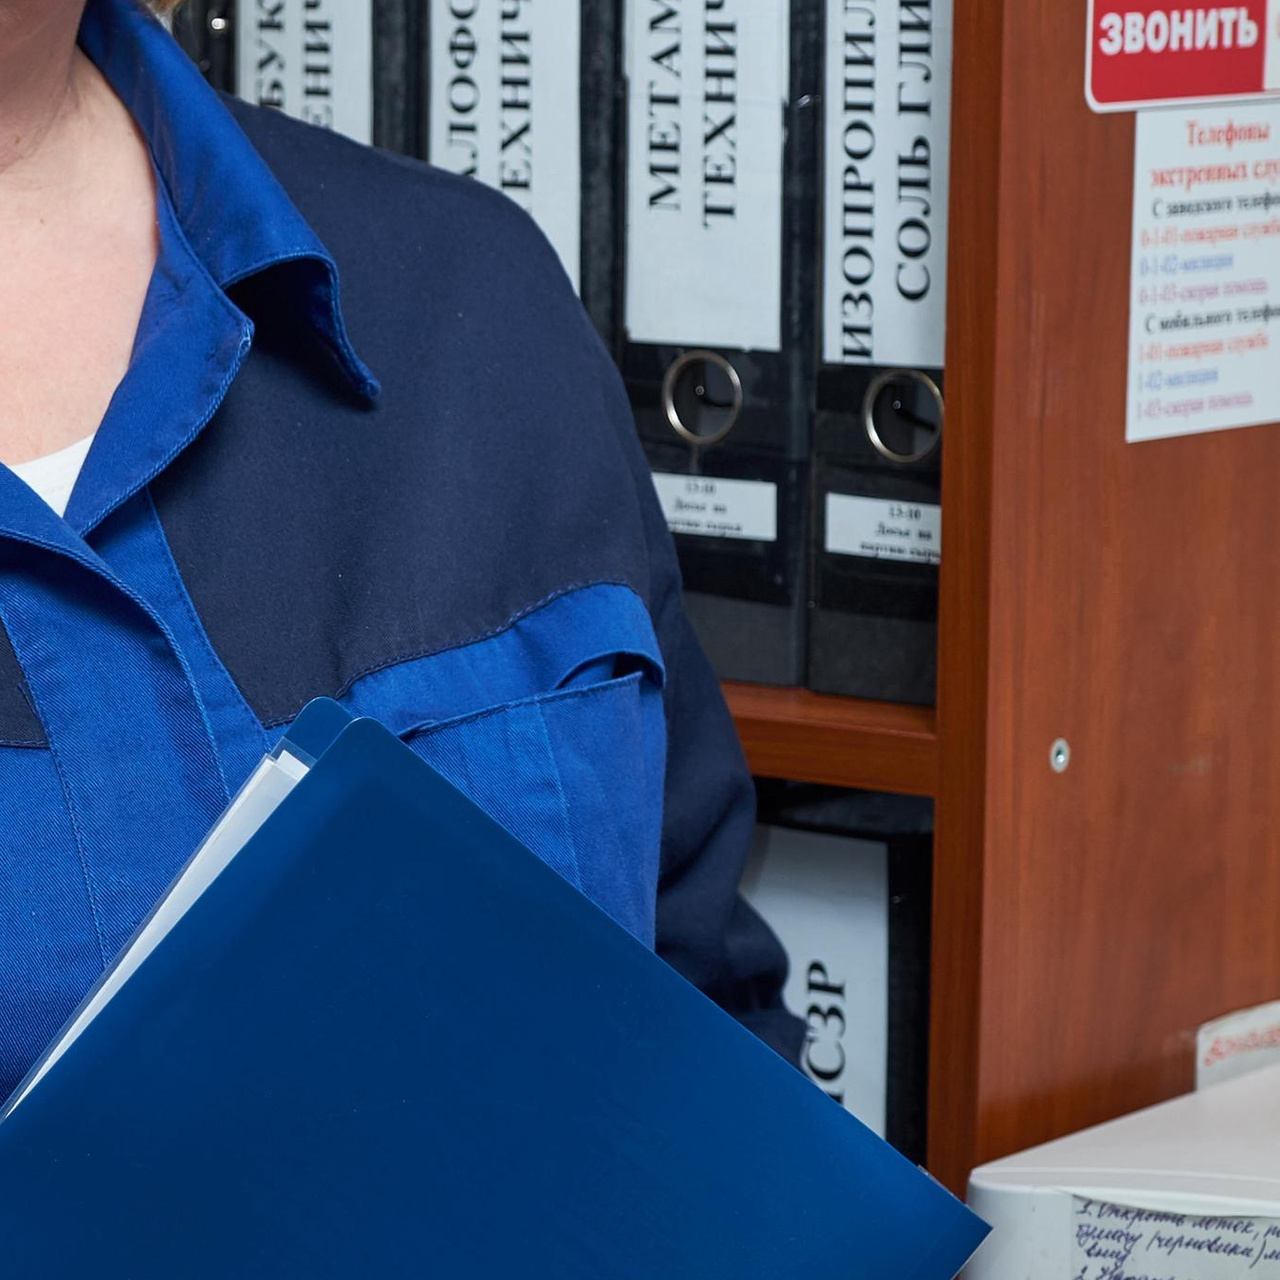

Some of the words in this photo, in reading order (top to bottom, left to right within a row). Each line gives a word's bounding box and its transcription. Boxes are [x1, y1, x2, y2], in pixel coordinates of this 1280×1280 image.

[1186, 118, 1269, 149] Телефоны
[1150, 163, 1247, 192] экстренных
[896, 135, 932, 301] СОЛЬ
